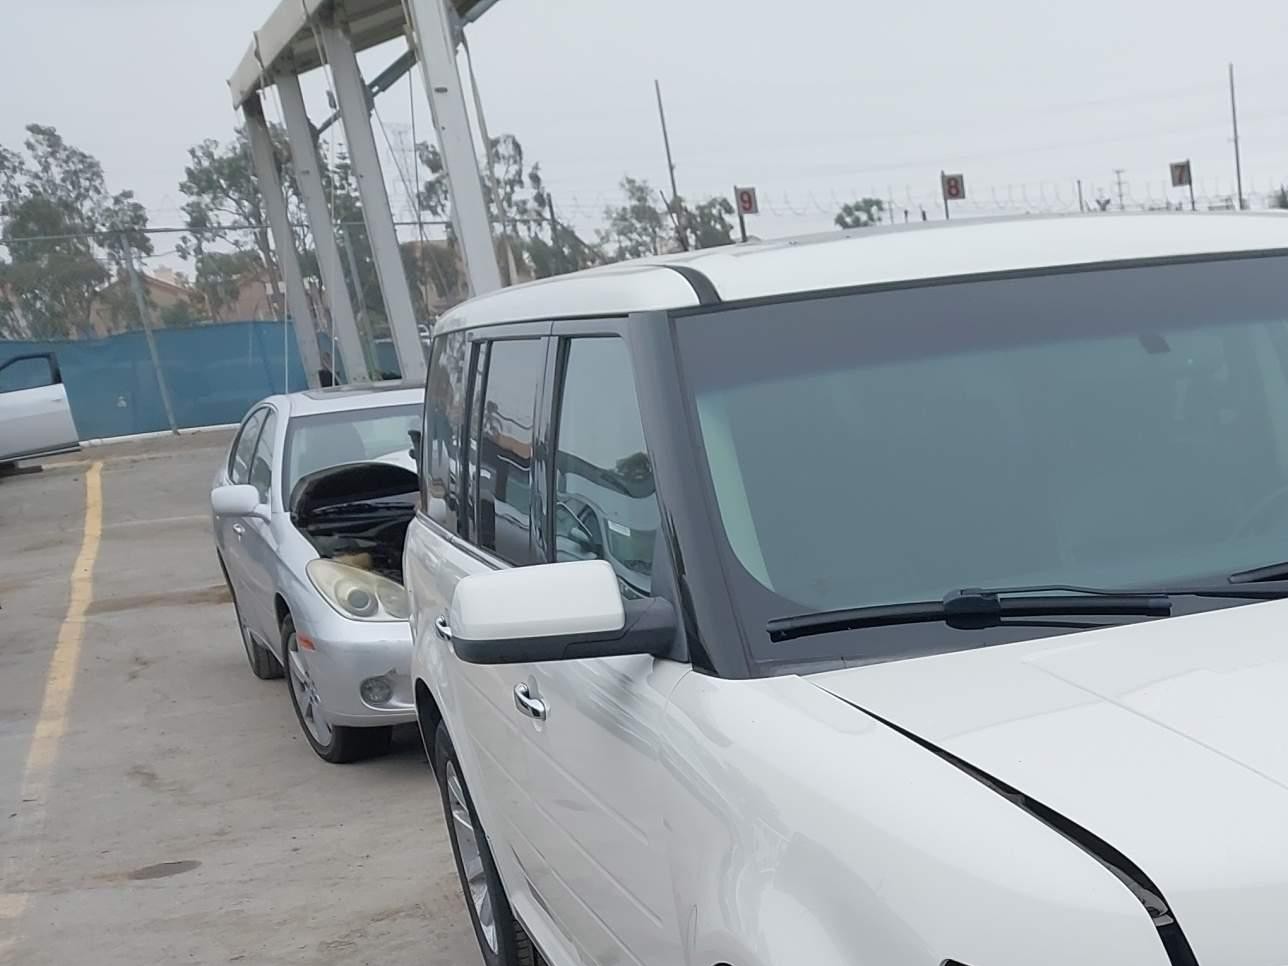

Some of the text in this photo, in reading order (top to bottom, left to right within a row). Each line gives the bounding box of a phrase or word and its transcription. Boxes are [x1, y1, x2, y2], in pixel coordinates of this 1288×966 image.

[1174, 165, 1185, 184] 7
[947, 177, 960, 197] 8
[740, 191, 752, 211] 9
